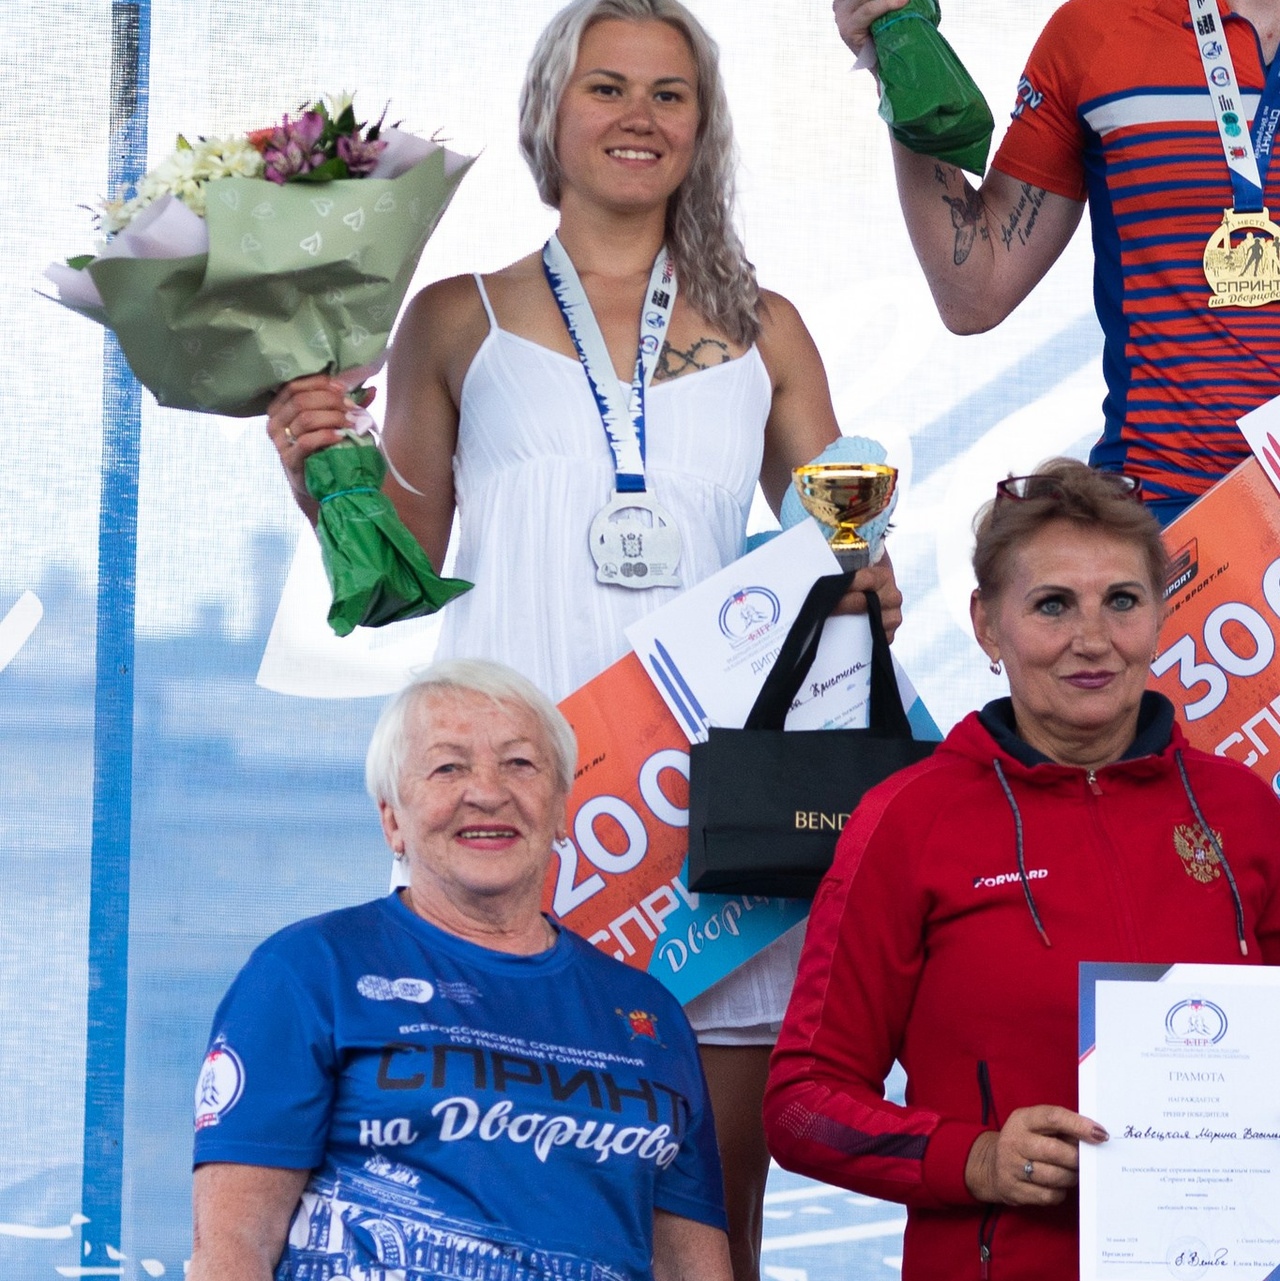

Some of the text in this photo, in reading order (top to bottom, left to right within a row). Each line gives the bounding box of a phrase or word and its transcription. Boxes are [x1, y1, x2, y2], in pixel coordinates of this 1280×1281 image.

[1260, 109, 1280, 155] СПРИНТ
[1237, 219, 1266, 228] МЕСТО
[1210, 297, 1225, 306] на
[749, 645, 784, 677] ДИПЛ
[398, 1022, 646, 1068] ВСЕРОССИЙСКИЕ СОРЕВНОВАНИЯ
[449, 1035, 609, 1070] ПО ЛЫЖНЫМ ГОНКАМ
[376, 1041, 688, 1138] СПРИНТ
[1168, 1071, 1226, 1083] ГРАМОТА
[1168, 1096, 1221, 1104] НАГРАЖДАЕТСЯ
[1187, 1111, 1230, 1119] ПОБЕДИТЕЛЯ
[359, 1096, 681, 1170] на Дворцово
